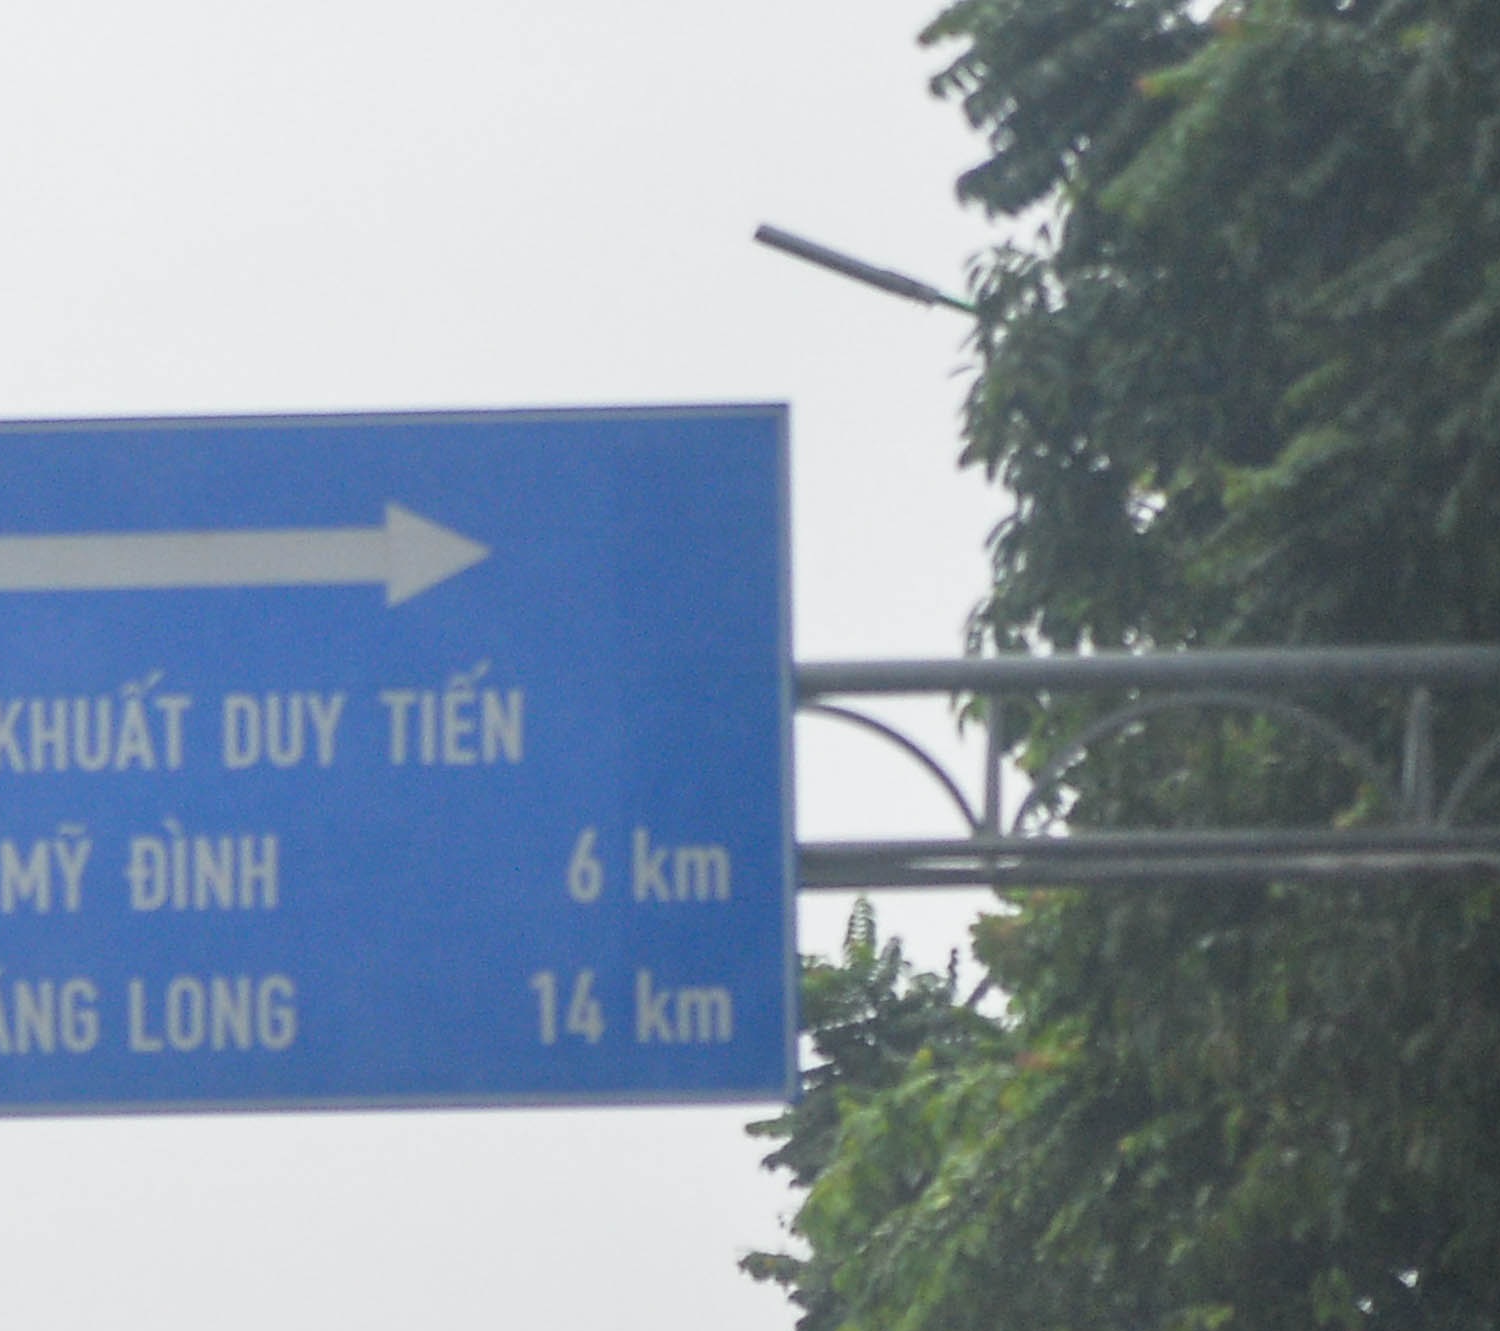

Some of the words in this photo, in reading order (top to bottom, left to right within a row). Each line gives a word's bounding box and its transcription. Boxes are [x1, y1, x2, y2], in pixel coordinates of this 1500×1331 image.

[224, 694, 343, 768] DUY
[382, 664, 523, 764] TIẾN
[0, 826, 90, 911] MỸ
[127, 820, 277, 910] ĐÌNH
[568, 829, 603, 902] 6
[633, 829, 730, 900] km
[130, 975, 296, 1051] LONG
[531, 971, 604, 1043] 14
[636, 971, 732, 1041] km
